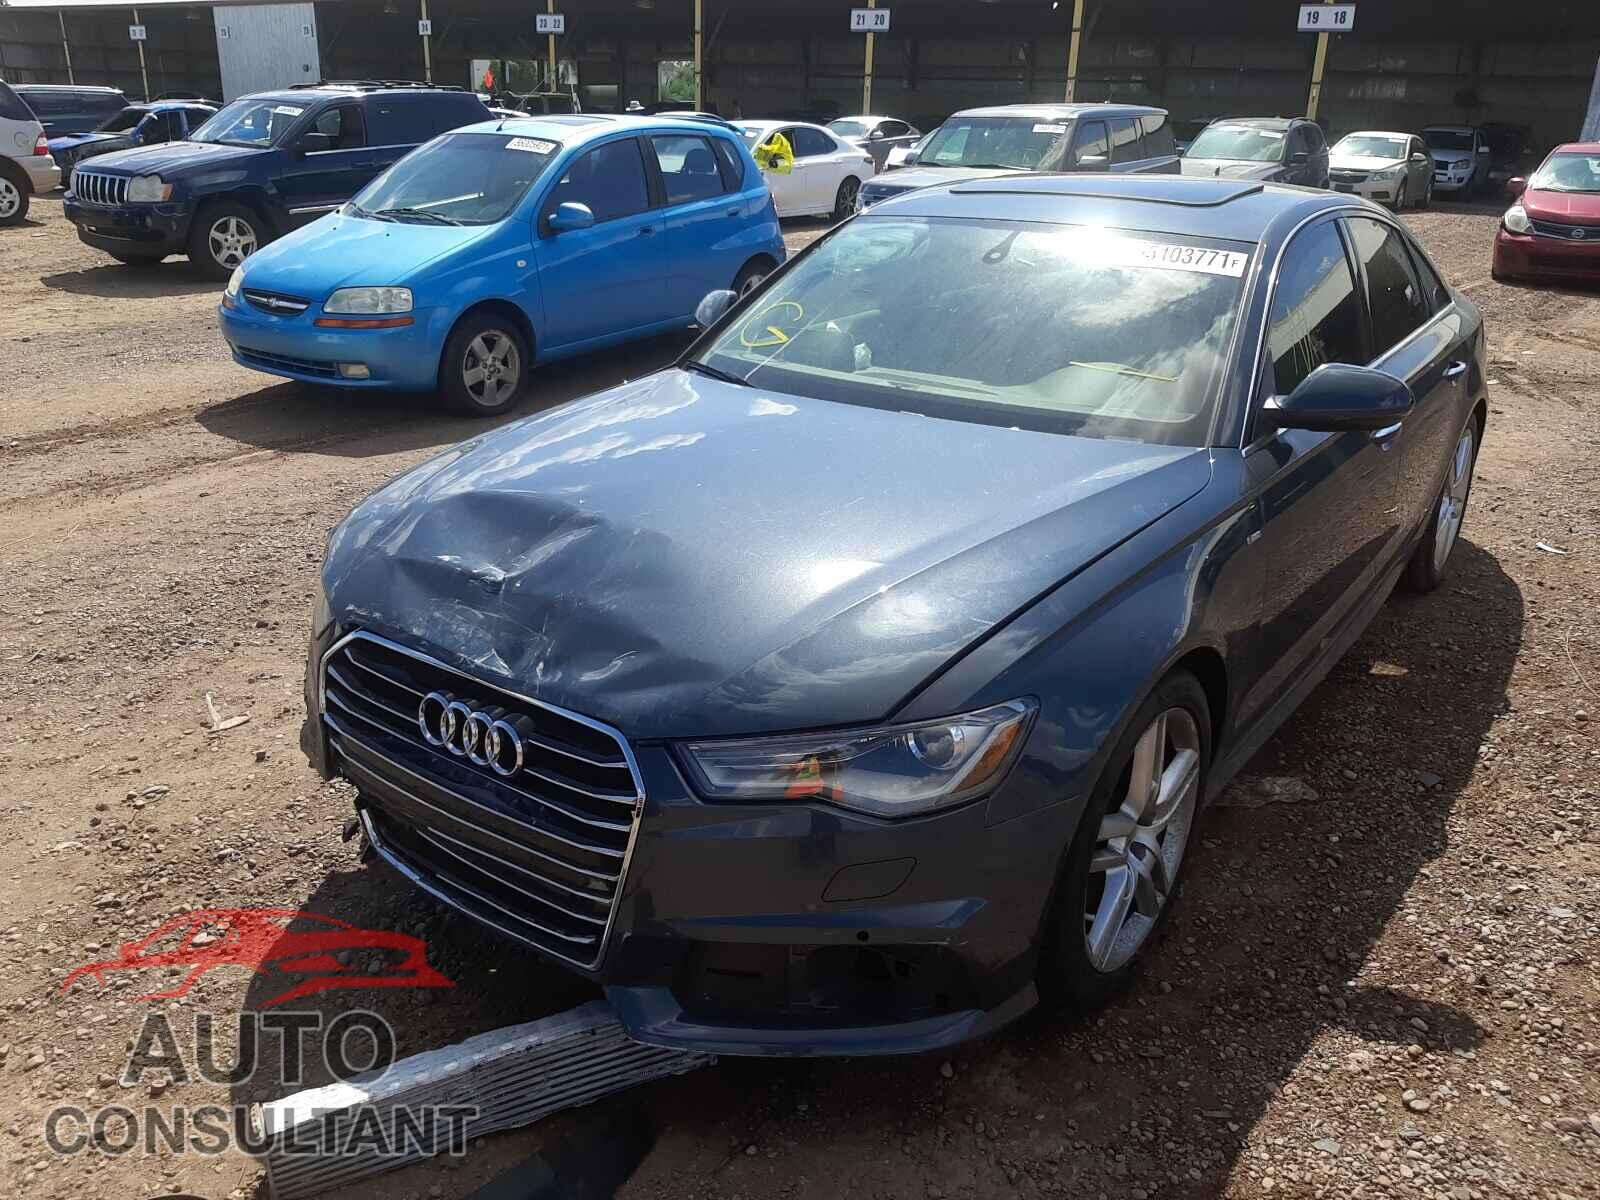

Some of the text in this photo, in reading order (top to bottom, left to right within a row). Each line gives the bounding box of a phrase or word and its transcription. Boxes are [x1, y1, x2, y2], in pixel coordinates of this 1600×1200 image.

[856, 14, 885, 25] 21 20
[1306, 10, 1347, 24] 19 18
